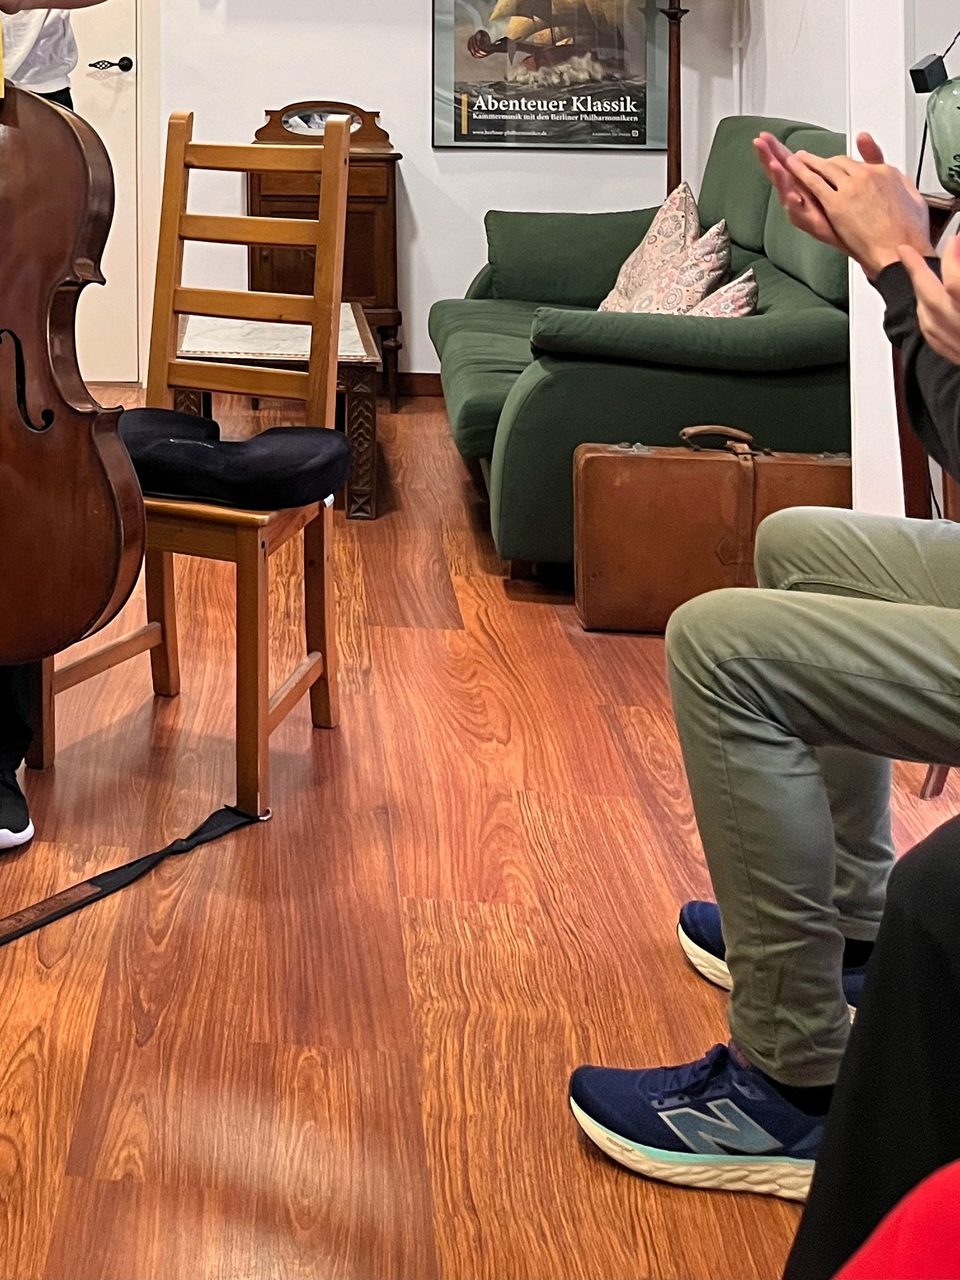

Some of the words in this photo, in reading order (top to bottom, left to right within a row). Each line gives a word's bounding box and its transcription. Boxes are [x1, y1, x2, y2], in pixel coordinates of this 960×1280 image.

[472, 95, 567, 112] Abenteuer
[571, 95, 638, 113] Klassik
[472, 112, 522, 120] Kammermusik
[550, 113, 579, 121] Berliner
[579, 113, 639, 122] Philharmonikern
